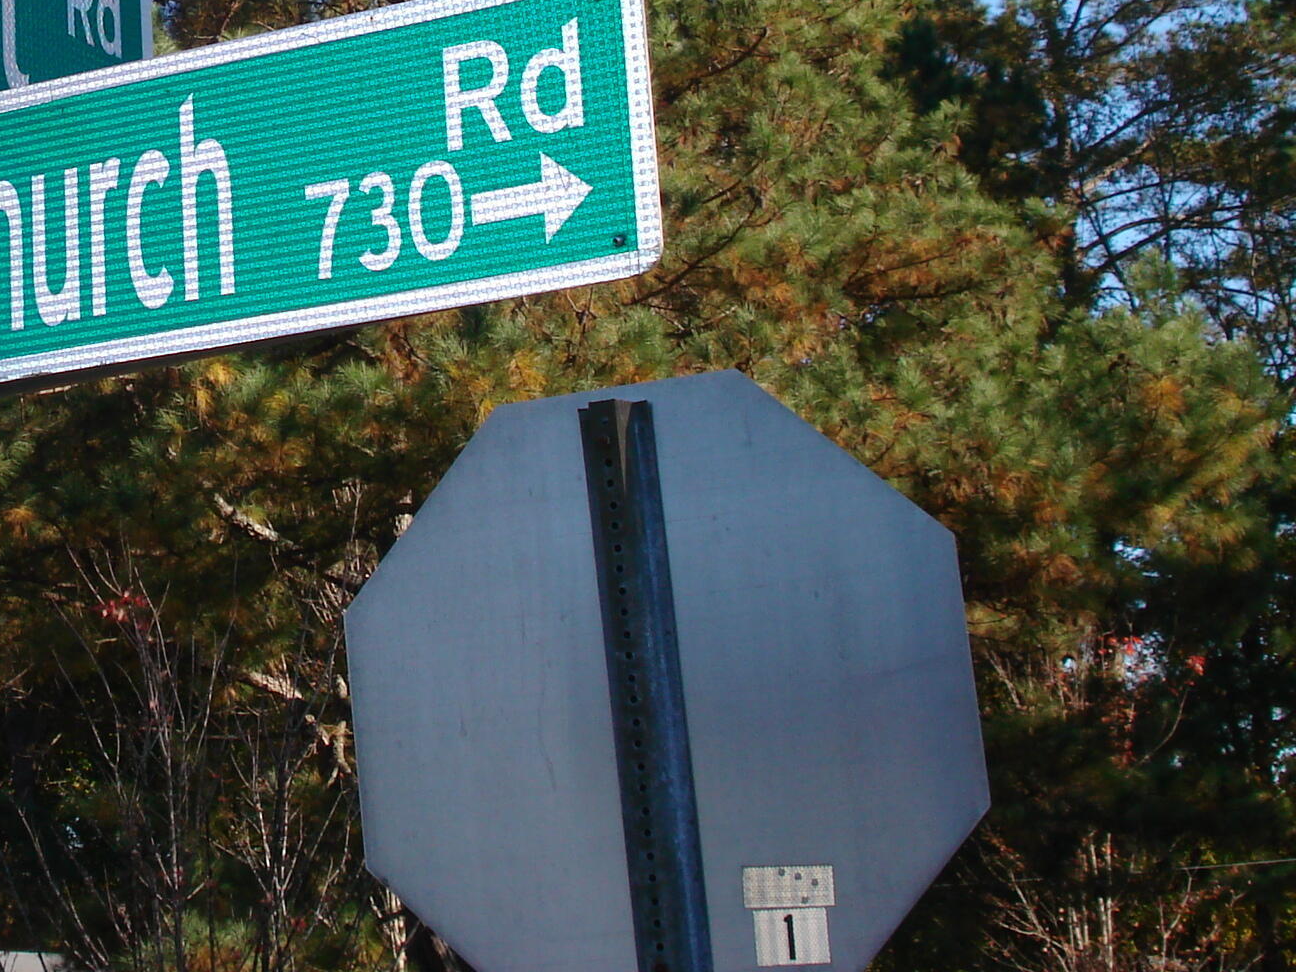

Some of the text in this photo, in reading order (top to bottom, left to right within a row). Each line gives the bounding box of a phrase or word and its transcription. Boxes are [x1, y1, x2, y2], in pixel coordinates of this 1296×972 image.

[442, 16, 585, 152] Rd
[305, 160, 465, 280] 730
[783, 913, 797, 961] 1
